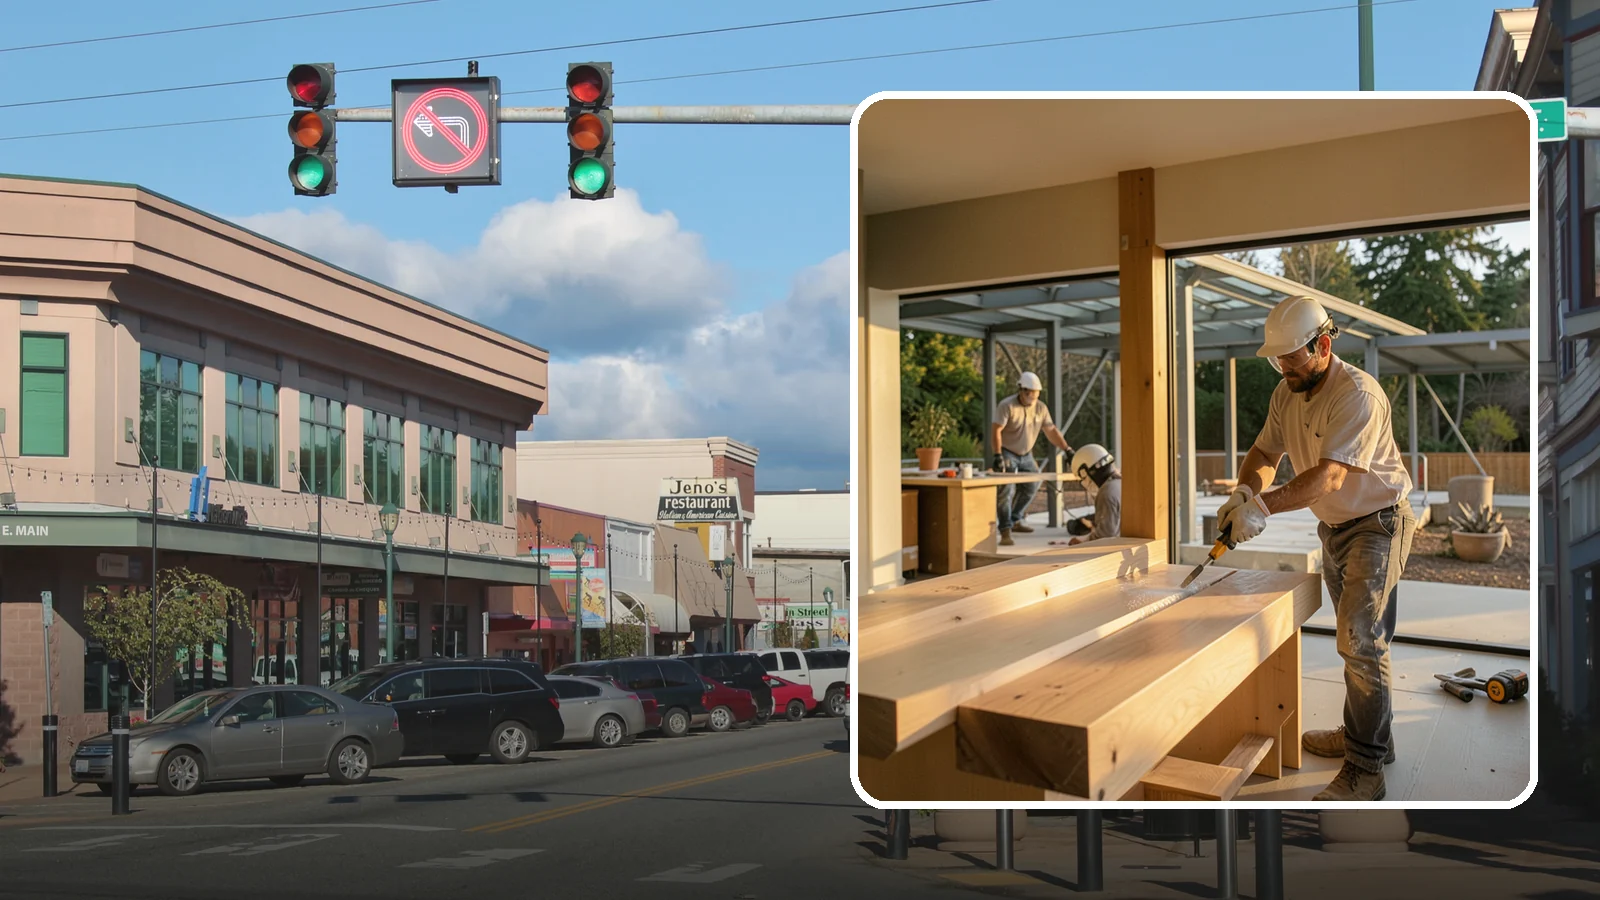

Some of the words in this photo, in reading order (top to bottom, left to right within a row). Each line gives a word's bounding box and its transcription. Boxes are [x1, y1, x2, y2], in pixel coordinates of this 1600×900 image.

[669, 480, 727, 494] Jeno's
[665, 496, 731, 509] restaurant
[658, 510, 681, 519] Italian
[686, 509, 714, 519] American
[715, 509, 737, 519] Cuisine
[2, 525, 13, 536] E.
[15, 525, 49, 536] MAIN
[786, 607, 795, 617] in
[797, 607, 829, 617] Street
[790, 619, 824, 627] lass
